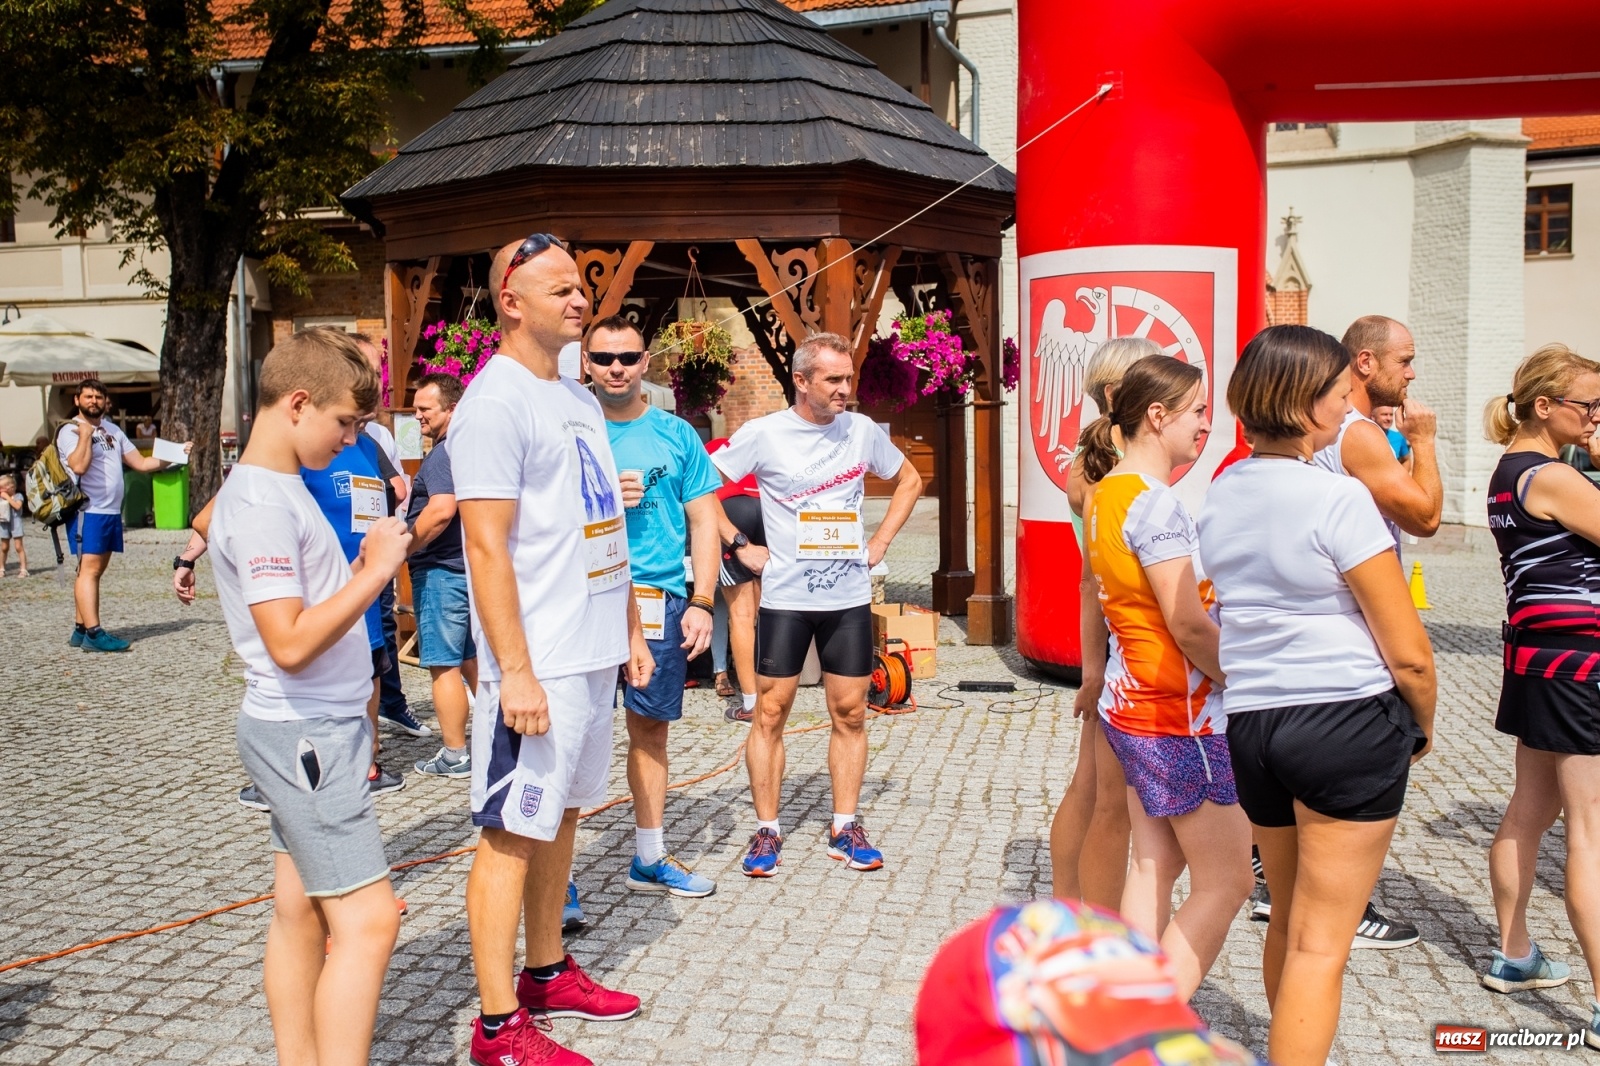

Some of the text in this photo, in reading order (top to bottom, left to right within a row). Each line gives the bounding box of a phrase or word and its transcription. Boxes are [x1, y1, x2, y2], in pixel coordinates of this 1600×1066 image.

[804, 457, 826, 476] GRYF
[371, 496, 381, 511] 36
[823, 528, 840, 541] 34
[606, 541, 618, 559] 44
